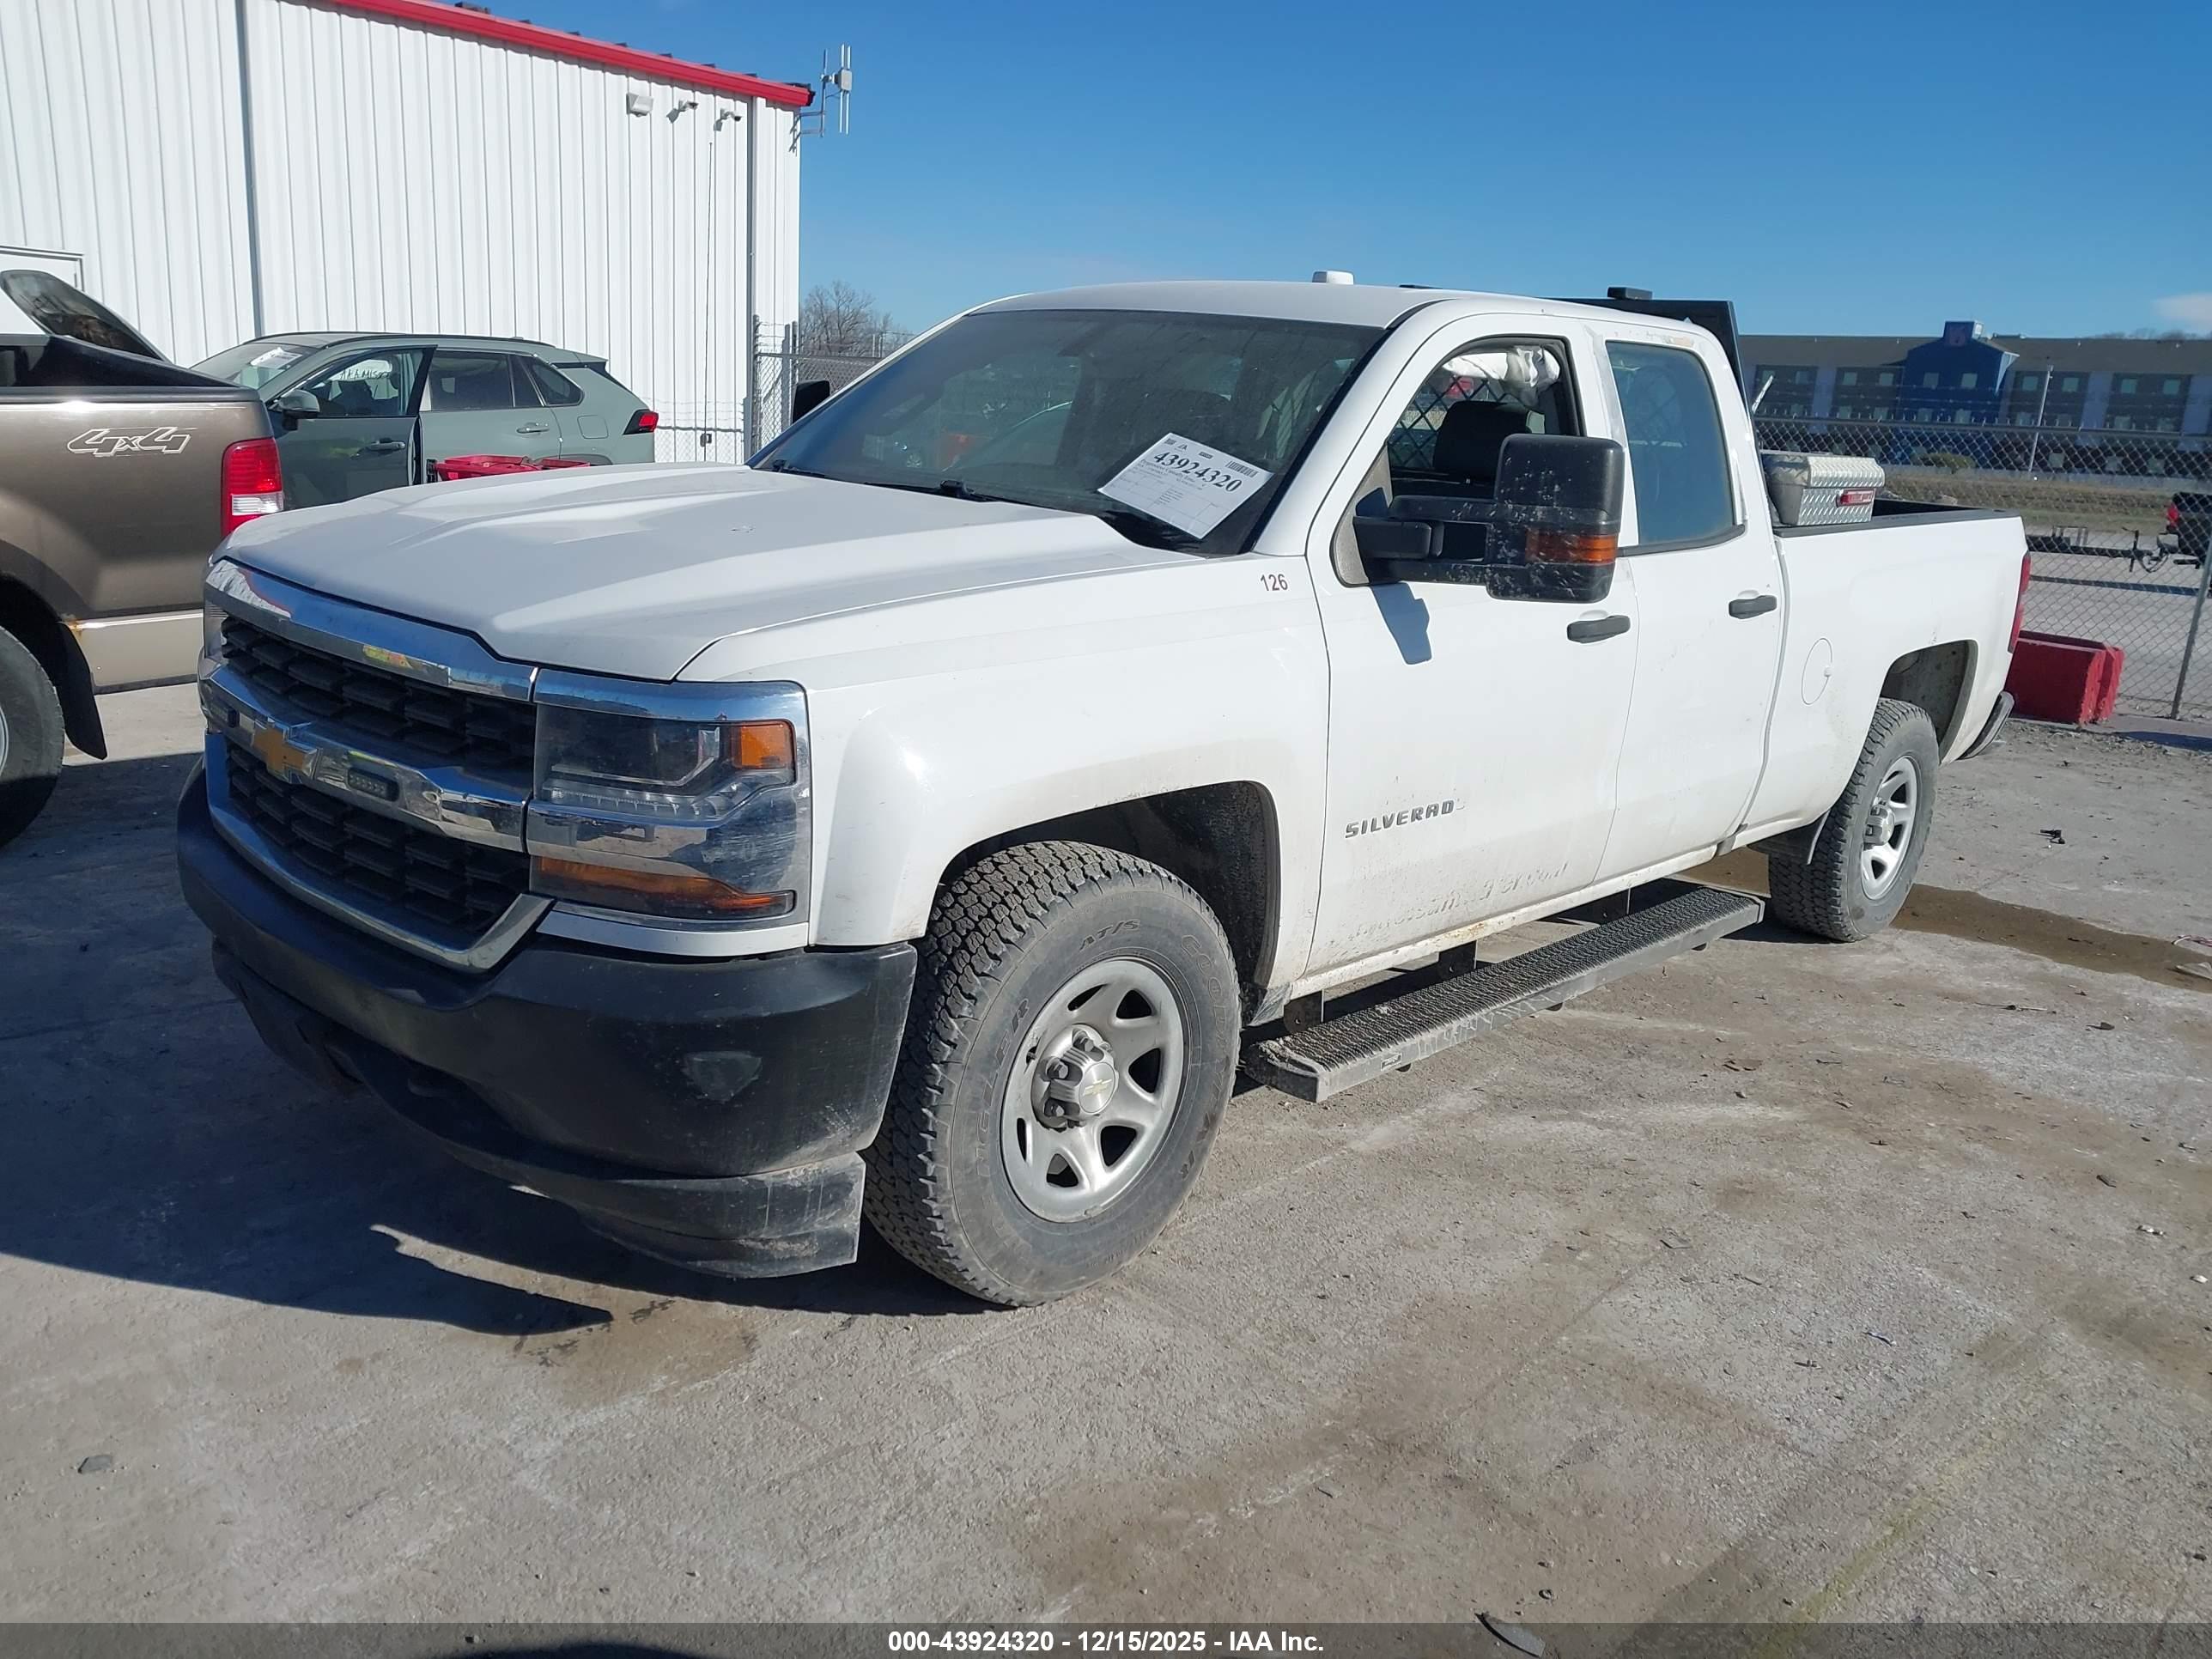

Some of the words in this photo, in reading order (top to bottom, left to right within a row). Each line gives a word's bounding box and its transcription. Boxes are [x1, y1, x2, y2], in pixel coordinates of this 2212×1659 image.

[67, 427, 191, 457] 4x4
[1154, 452, 1243, 492] 43924320
[1260, 573, 1288, 592] 126
[1079, 918, 1140, 952] AT/S
